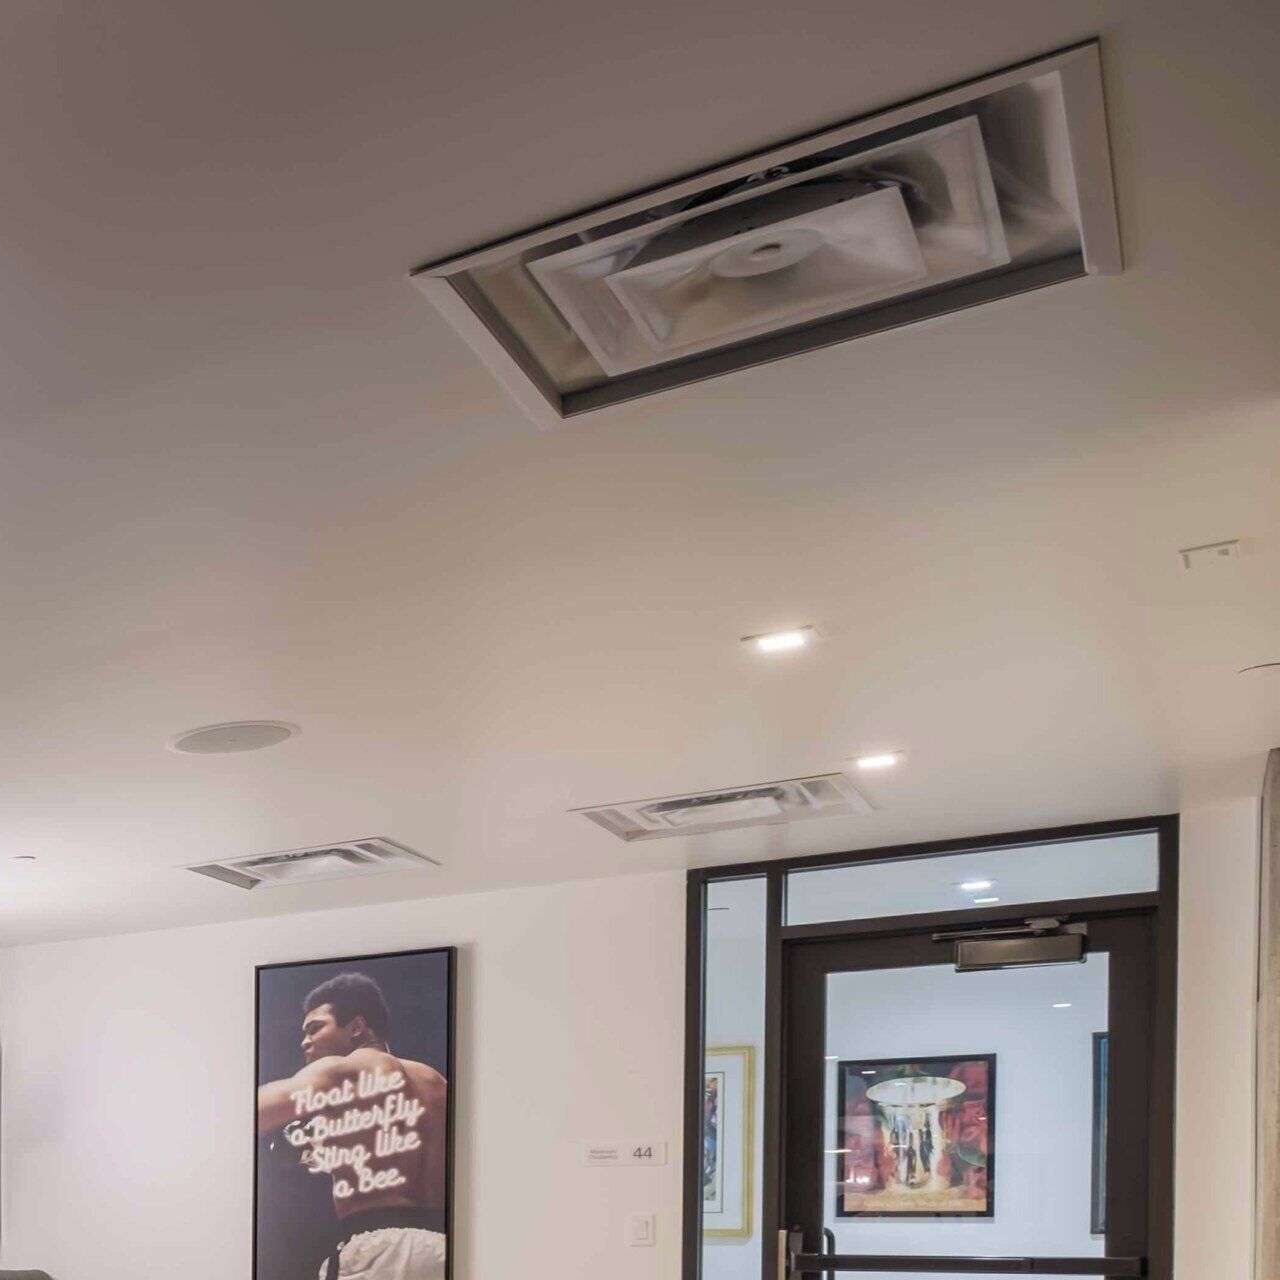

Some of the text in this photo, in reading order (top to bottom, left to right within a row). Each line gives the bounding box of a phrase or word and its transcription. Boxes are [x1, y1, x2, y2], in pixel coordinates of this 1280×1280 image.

[290, 1066, 406, 1115] Float like
[290, 1092, 425, 1146] a Butterfly
[308, 1126, 421, 1176] Sting like
[632, 1146, 653, 1159] 44
[334, 1179, 355, 1198] a
